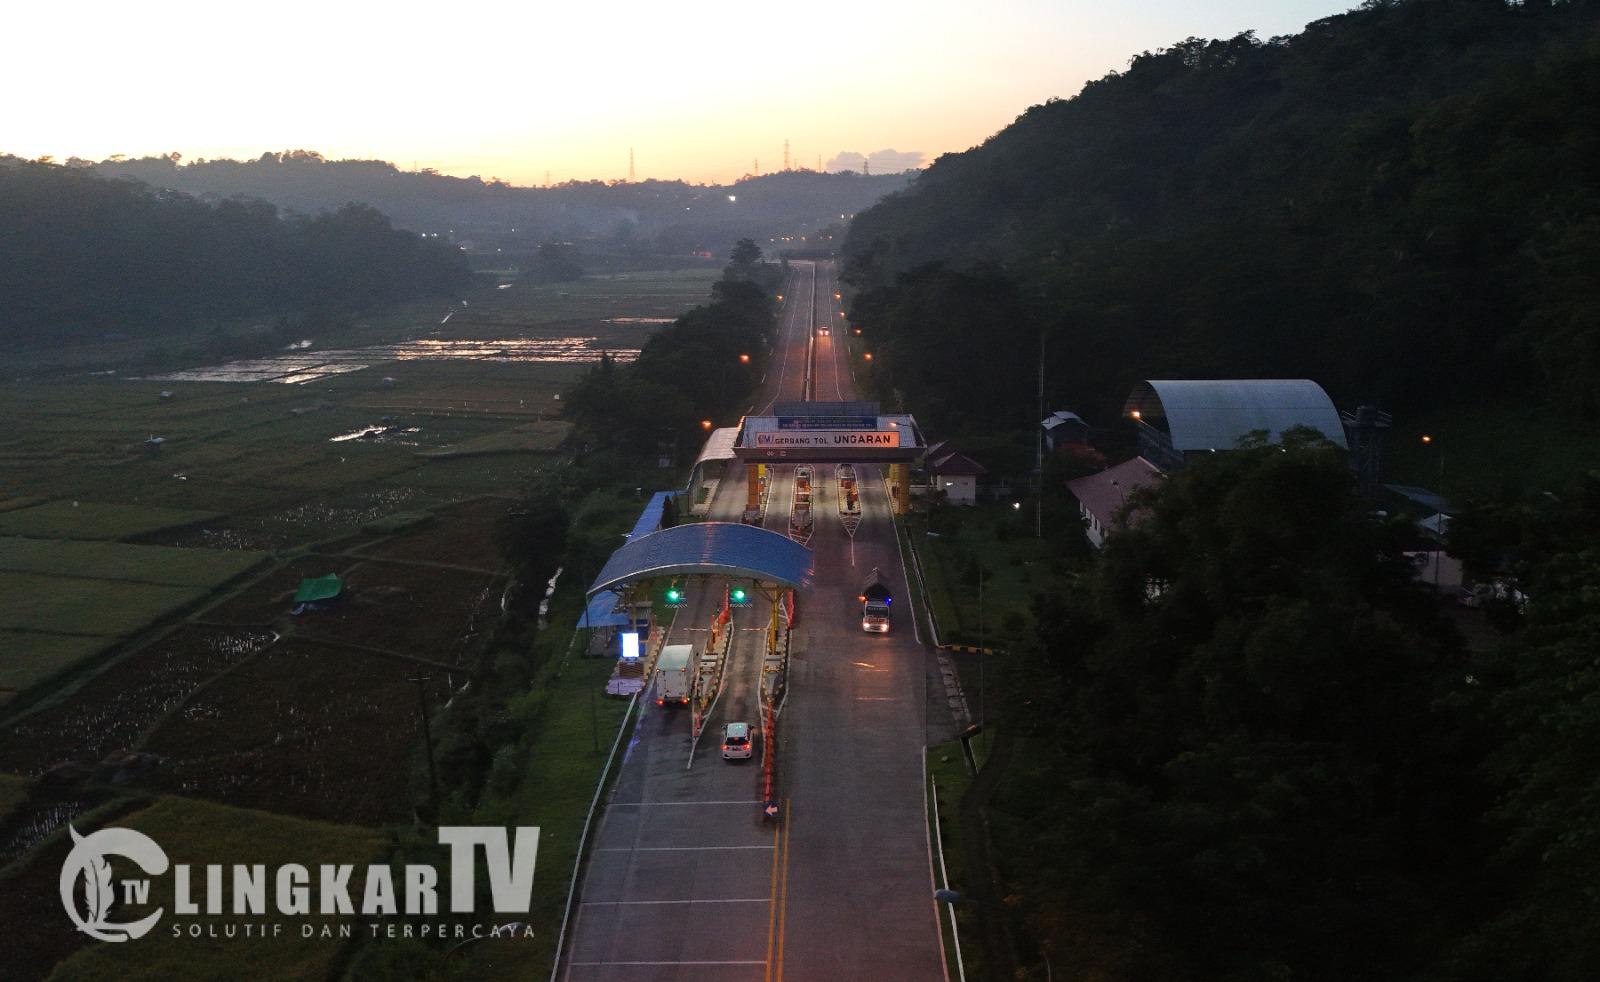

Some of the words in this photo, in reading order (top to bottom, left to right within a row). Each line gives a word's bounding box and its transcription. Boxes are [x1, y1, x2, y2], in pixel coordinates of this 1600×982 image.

[775, 437, 810, 445] GERBANG
[814, 437, 828, 445] TOL
[834, 434, 891, 444] UNGARAN
